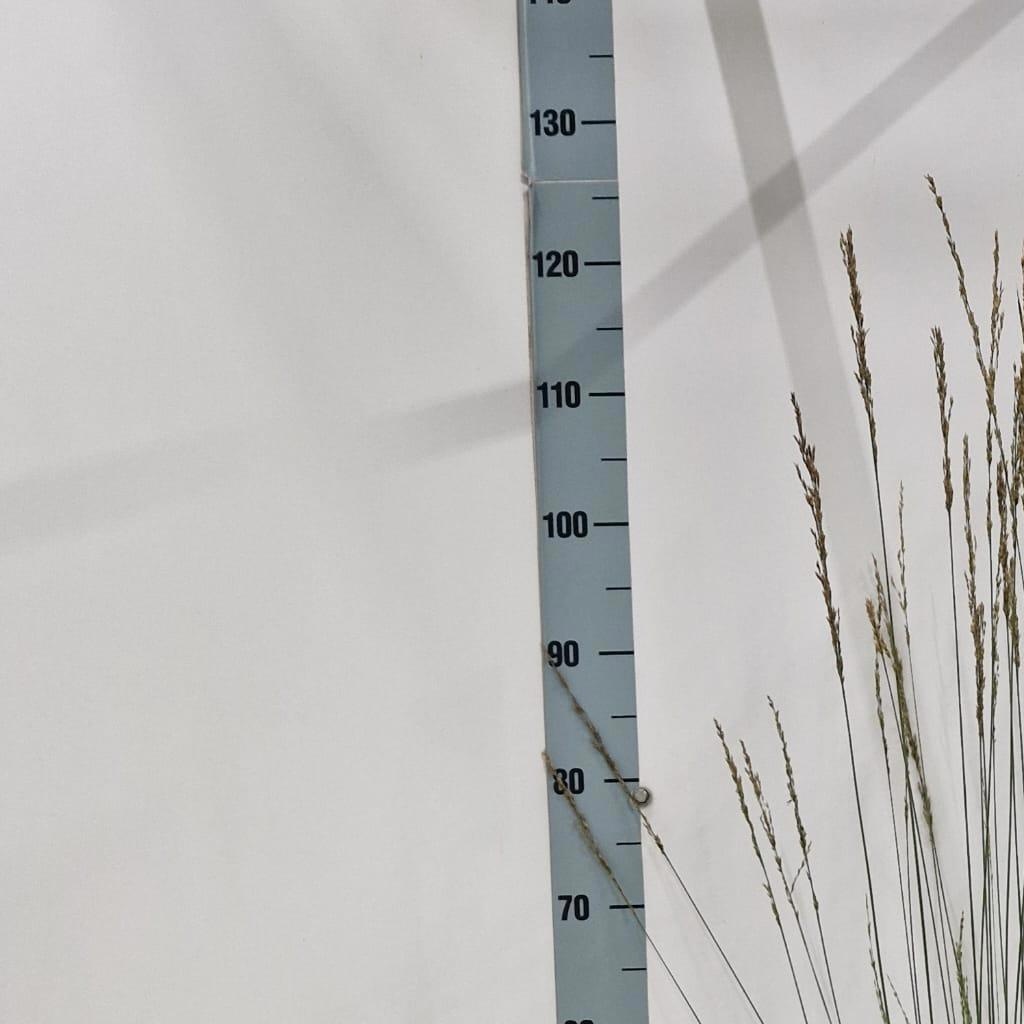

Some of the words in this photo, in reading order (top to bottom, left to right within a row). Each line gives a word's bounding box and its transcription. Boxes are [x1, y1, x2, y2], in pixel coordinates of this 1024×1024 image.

[529, 108, 576, 137] 130
[532, 250, 579, 278] 120
[536, 381, 581, 409] 110
[542, 511, 589, 539] 100
[547, 640, 580, 668] 90
[552, 767, 585, 795] 80
[557, 894, 590, 921] 70
